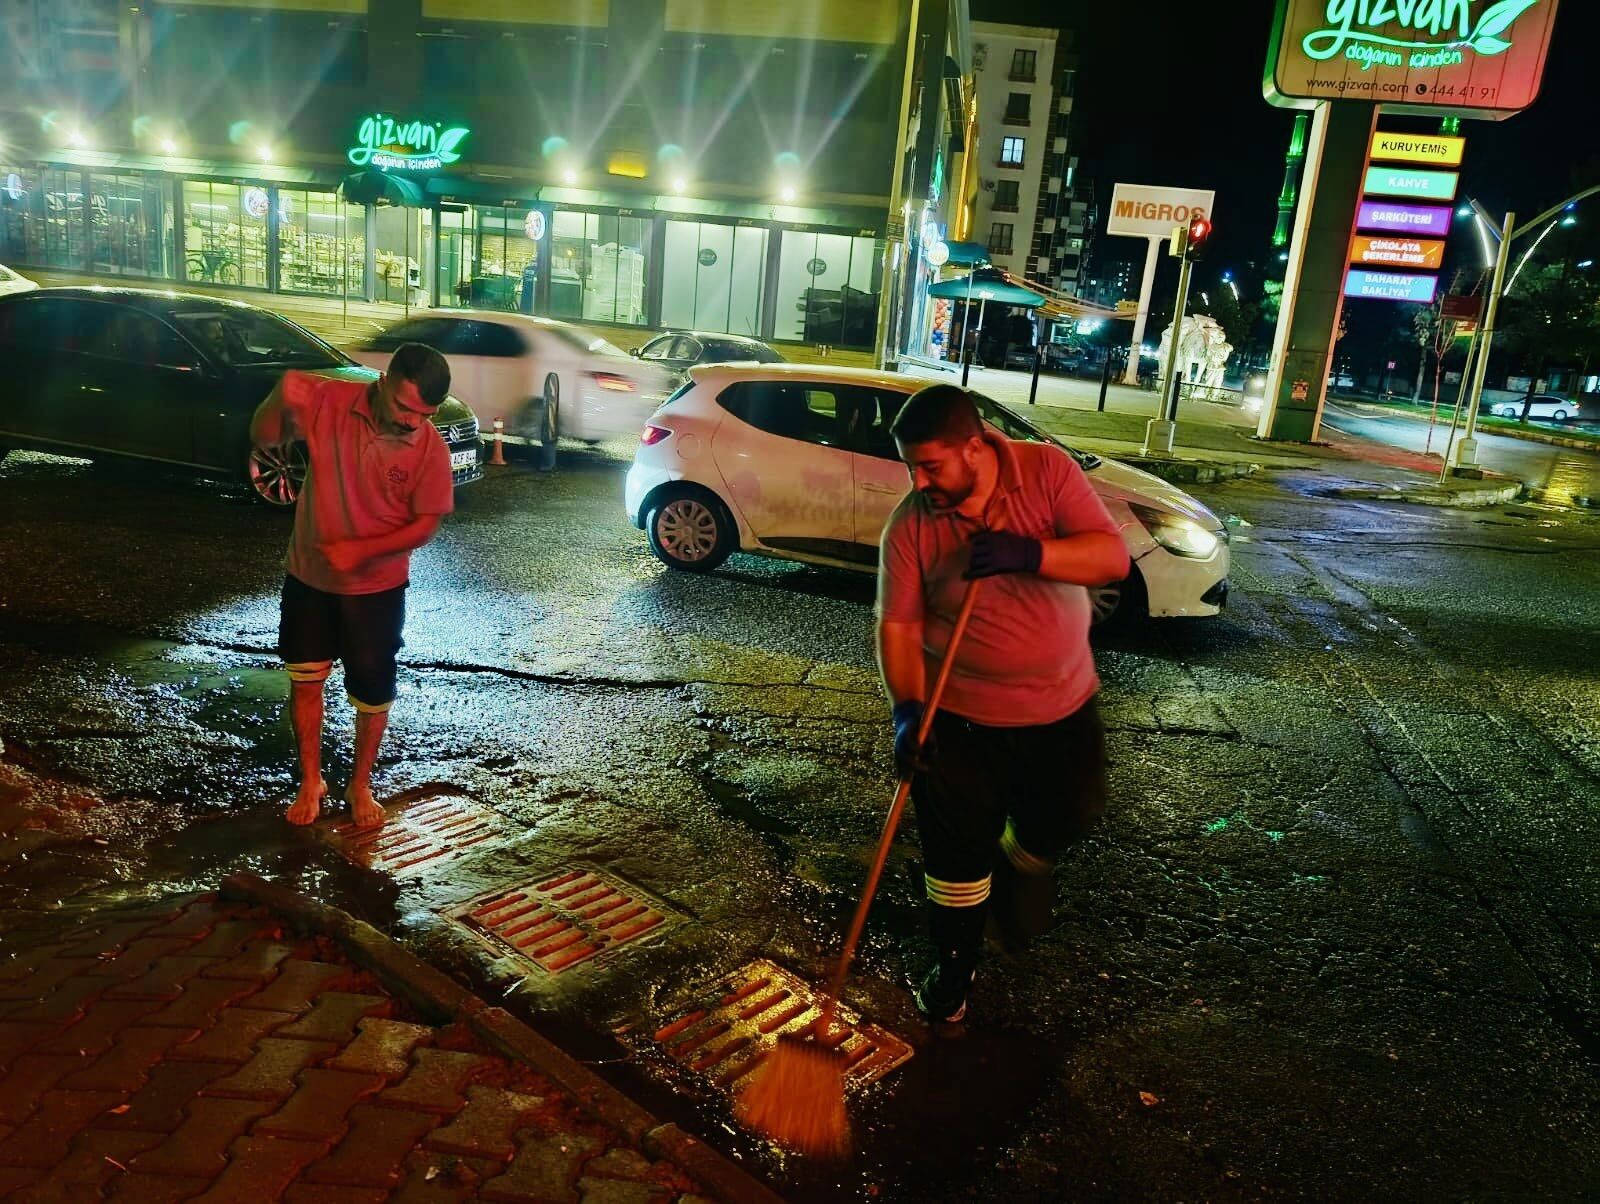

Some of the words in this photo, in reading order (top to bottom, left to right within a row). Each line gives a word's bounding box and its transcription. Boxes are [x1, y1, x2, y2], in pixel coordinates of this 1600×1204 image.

[1306, 78, 1409, 94] www.gizvan.com
[1430, 85, 1455, 96] 444
[1458, 87, 1475, 98] 41
[1480, 88, 1497, 100] 91
[349, 113, 441, 165] gizvan
[1389, 177, 1429, 189] KAHVE
[1372, 211, 1432, 224] ŞARKÜTERİ
[1370, 240, 1421, 252] ÇİKOLATA
[1362, 250, 1426, 263] ŞEKERLEME
[1365, 274, 1413, 285] BAHARAT
[1362, 285, 1411, 297] BAKLİYAT
